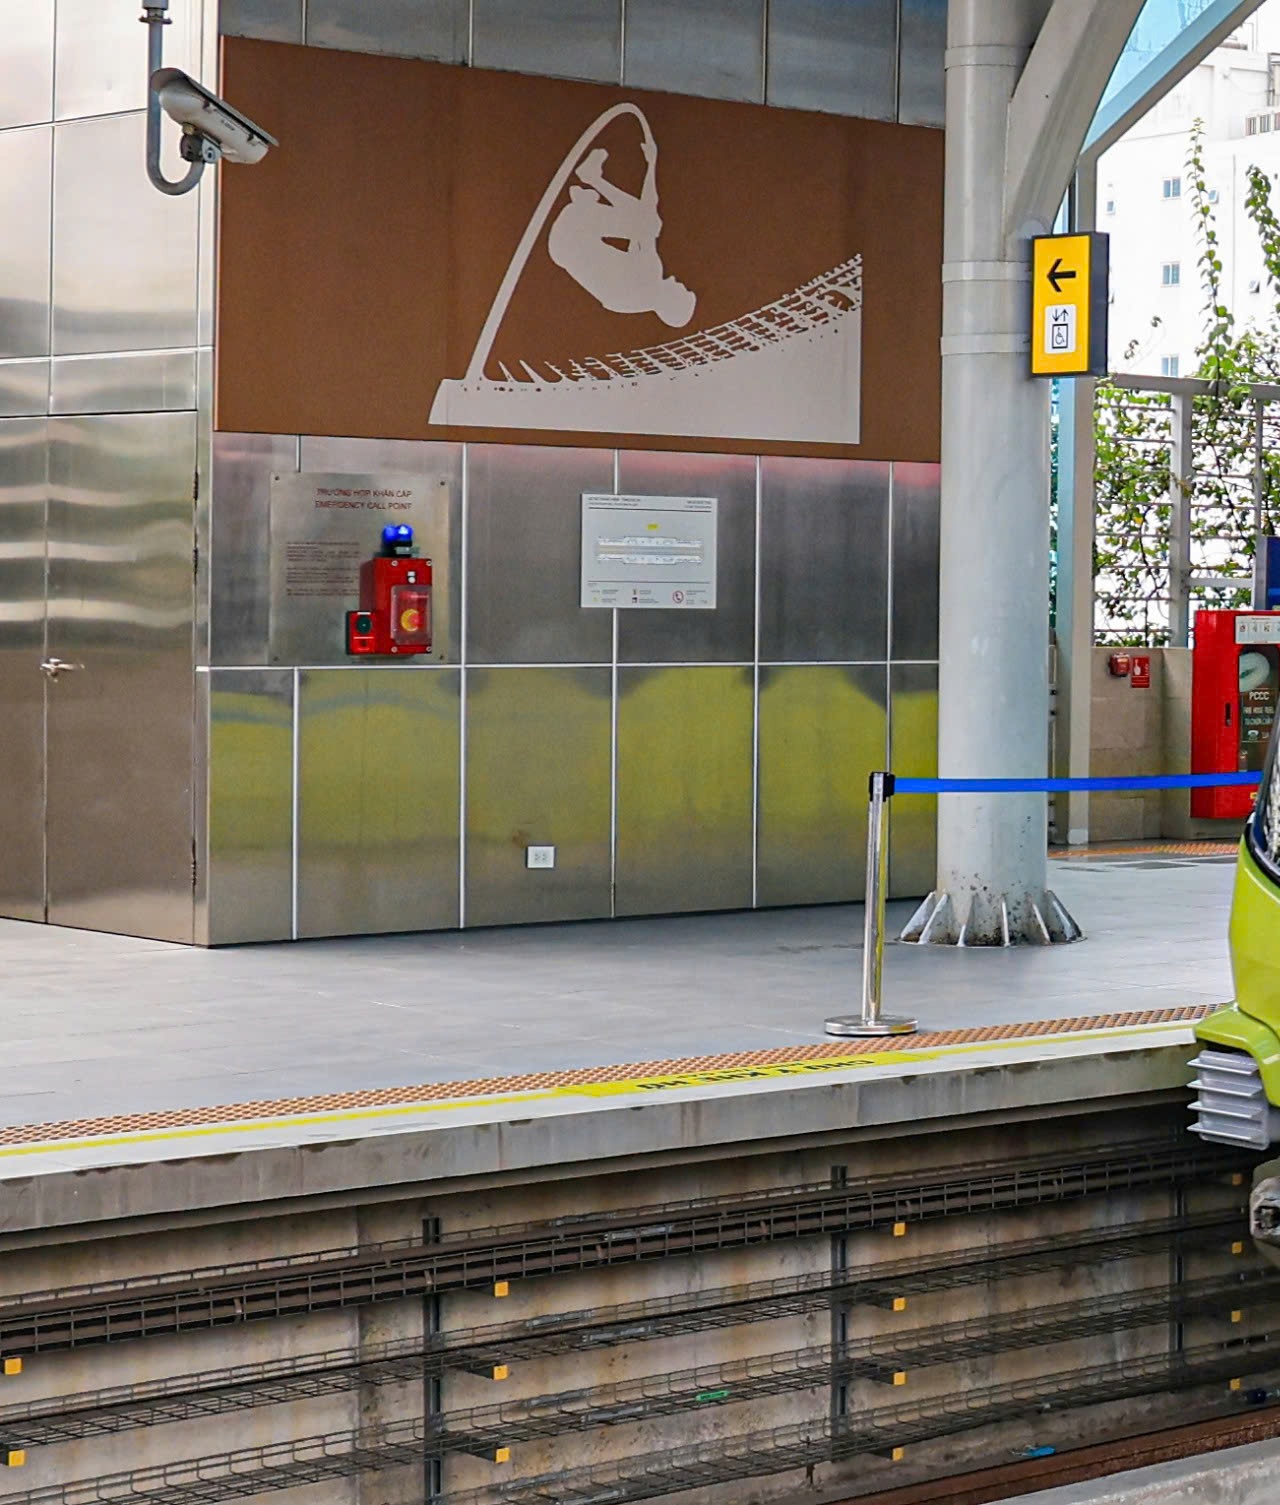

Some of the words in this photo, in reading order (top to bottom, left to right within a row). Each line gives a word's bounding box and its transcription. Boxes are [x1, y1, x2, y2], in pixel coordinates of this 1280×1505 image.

[367, 501, 386, 510] CALL
[388, 502, 412, 510] POINT
[1249, 691, 1270, 701] PCCC
